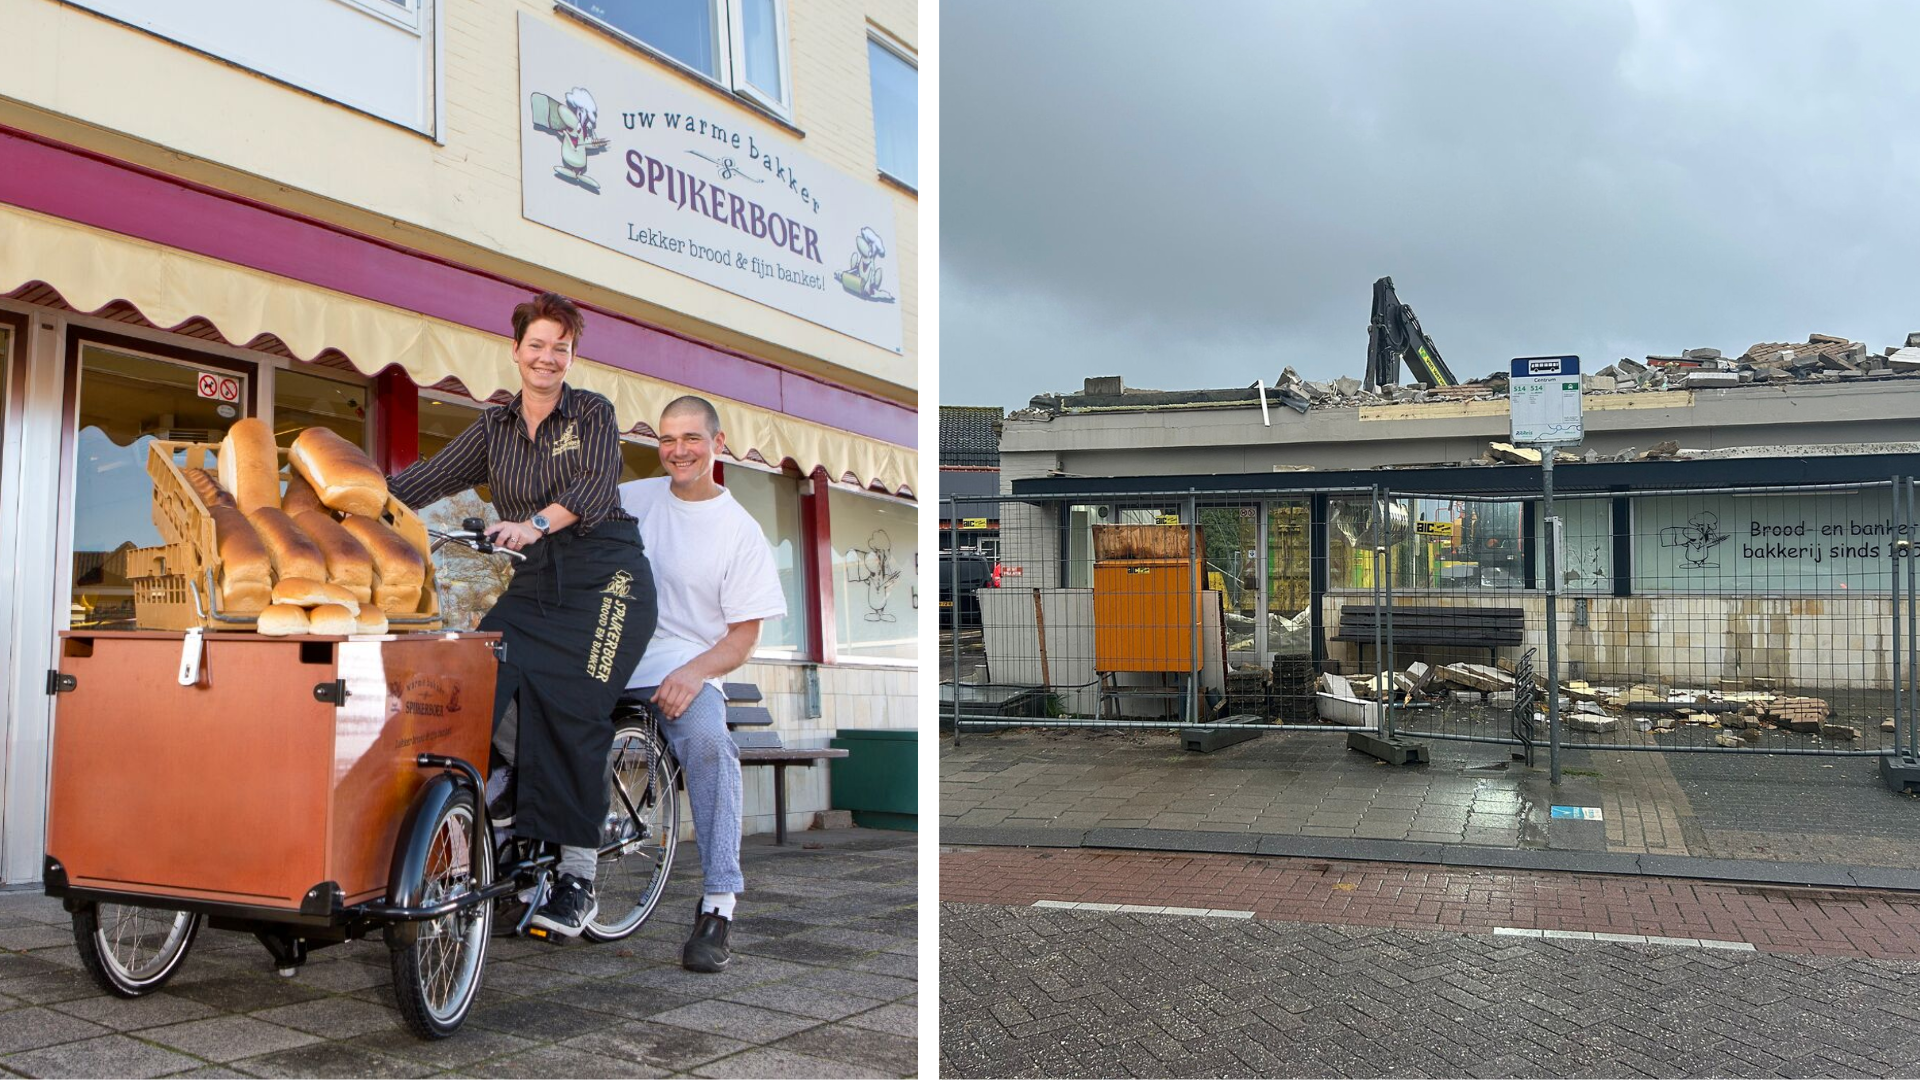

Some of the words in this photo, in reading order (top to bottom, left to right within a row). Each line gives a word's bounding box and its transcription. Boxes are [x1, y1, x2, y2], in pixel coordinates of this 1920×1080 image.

[622, 112, 655, 130] uw
[664, 112, 740, 149] warme
[748, 136, 820, 214] bakker
[625, 149, 823, 264] SPIJKERBOER
[627, 222, 685, 254] Lekker
[689, 239, 732, 267] brood
[735, 252, 748, 270] &
[751, 257, 774, 279] fijn
[777, 263, 826, 291] banket!
[1821, 524, 1844, 536] en
[1743, 542, 1822, 563] bakkerij
[1829, 542, 1879, 558] sinds
[599, 596, 612, 627] BROOD
[594, 627, 605, 640] EN
[595, 599, 627, 683] SPIJKERBOER
[586, 641, 601, 678] BANKET
